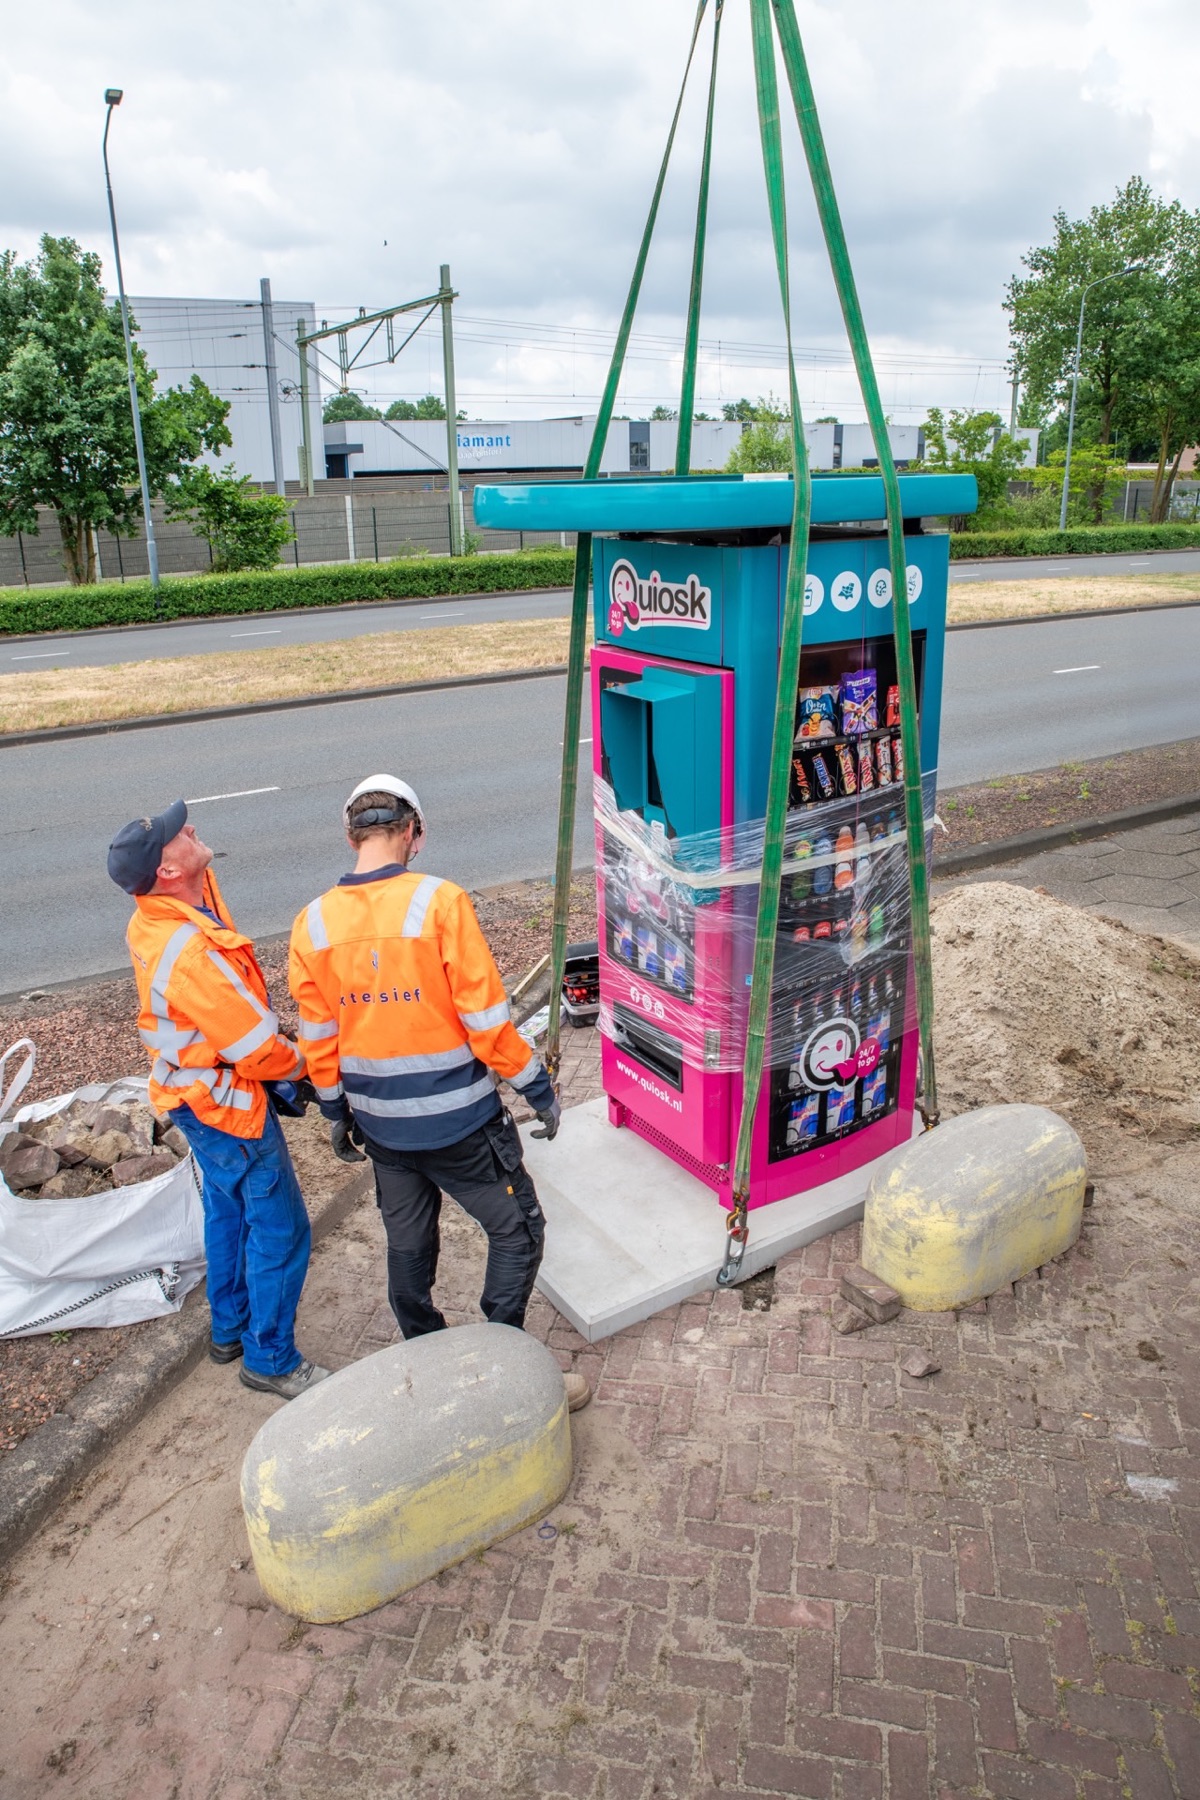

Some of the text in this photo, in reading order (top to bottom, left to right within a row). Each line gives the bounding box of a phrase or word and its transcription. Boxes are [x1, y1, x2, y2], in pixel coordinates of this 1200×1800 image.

[457, 434, 511, 447] iamant
[612, 564, 707, 625] Quiosk
[340, 988, 420, 1006] xtesief
[859, 1044, 875, 1059] 24/7
[858, 1055, 875, 1068] to go
[616, 1060, 682, 1113] www.quiosk.nl
